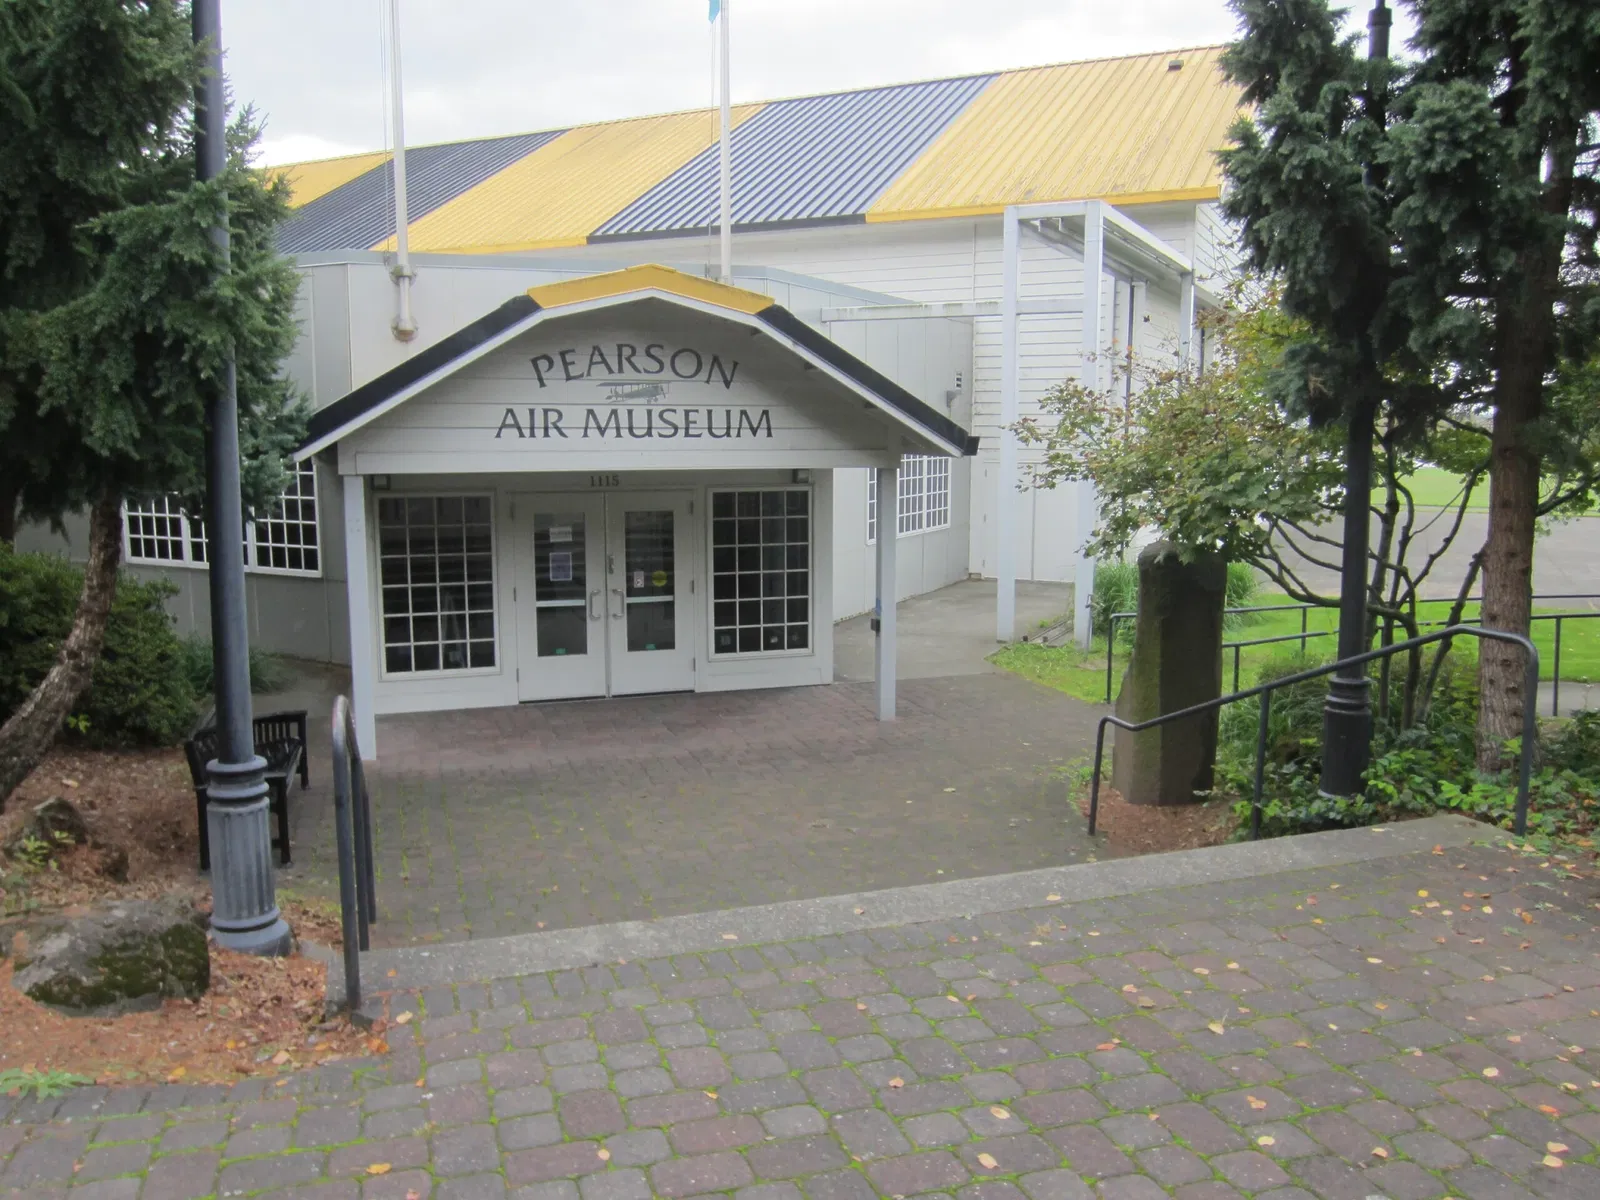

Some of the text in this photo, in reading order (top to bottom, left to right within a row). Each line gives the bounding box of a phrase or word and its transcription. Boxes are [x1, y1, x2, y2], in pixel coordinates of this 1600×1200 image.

[530, 343, 740, 390] PEARSON
[495, 408, 774, 439] AIR MUSEUM
[590, 474, 620, 487] 1115
